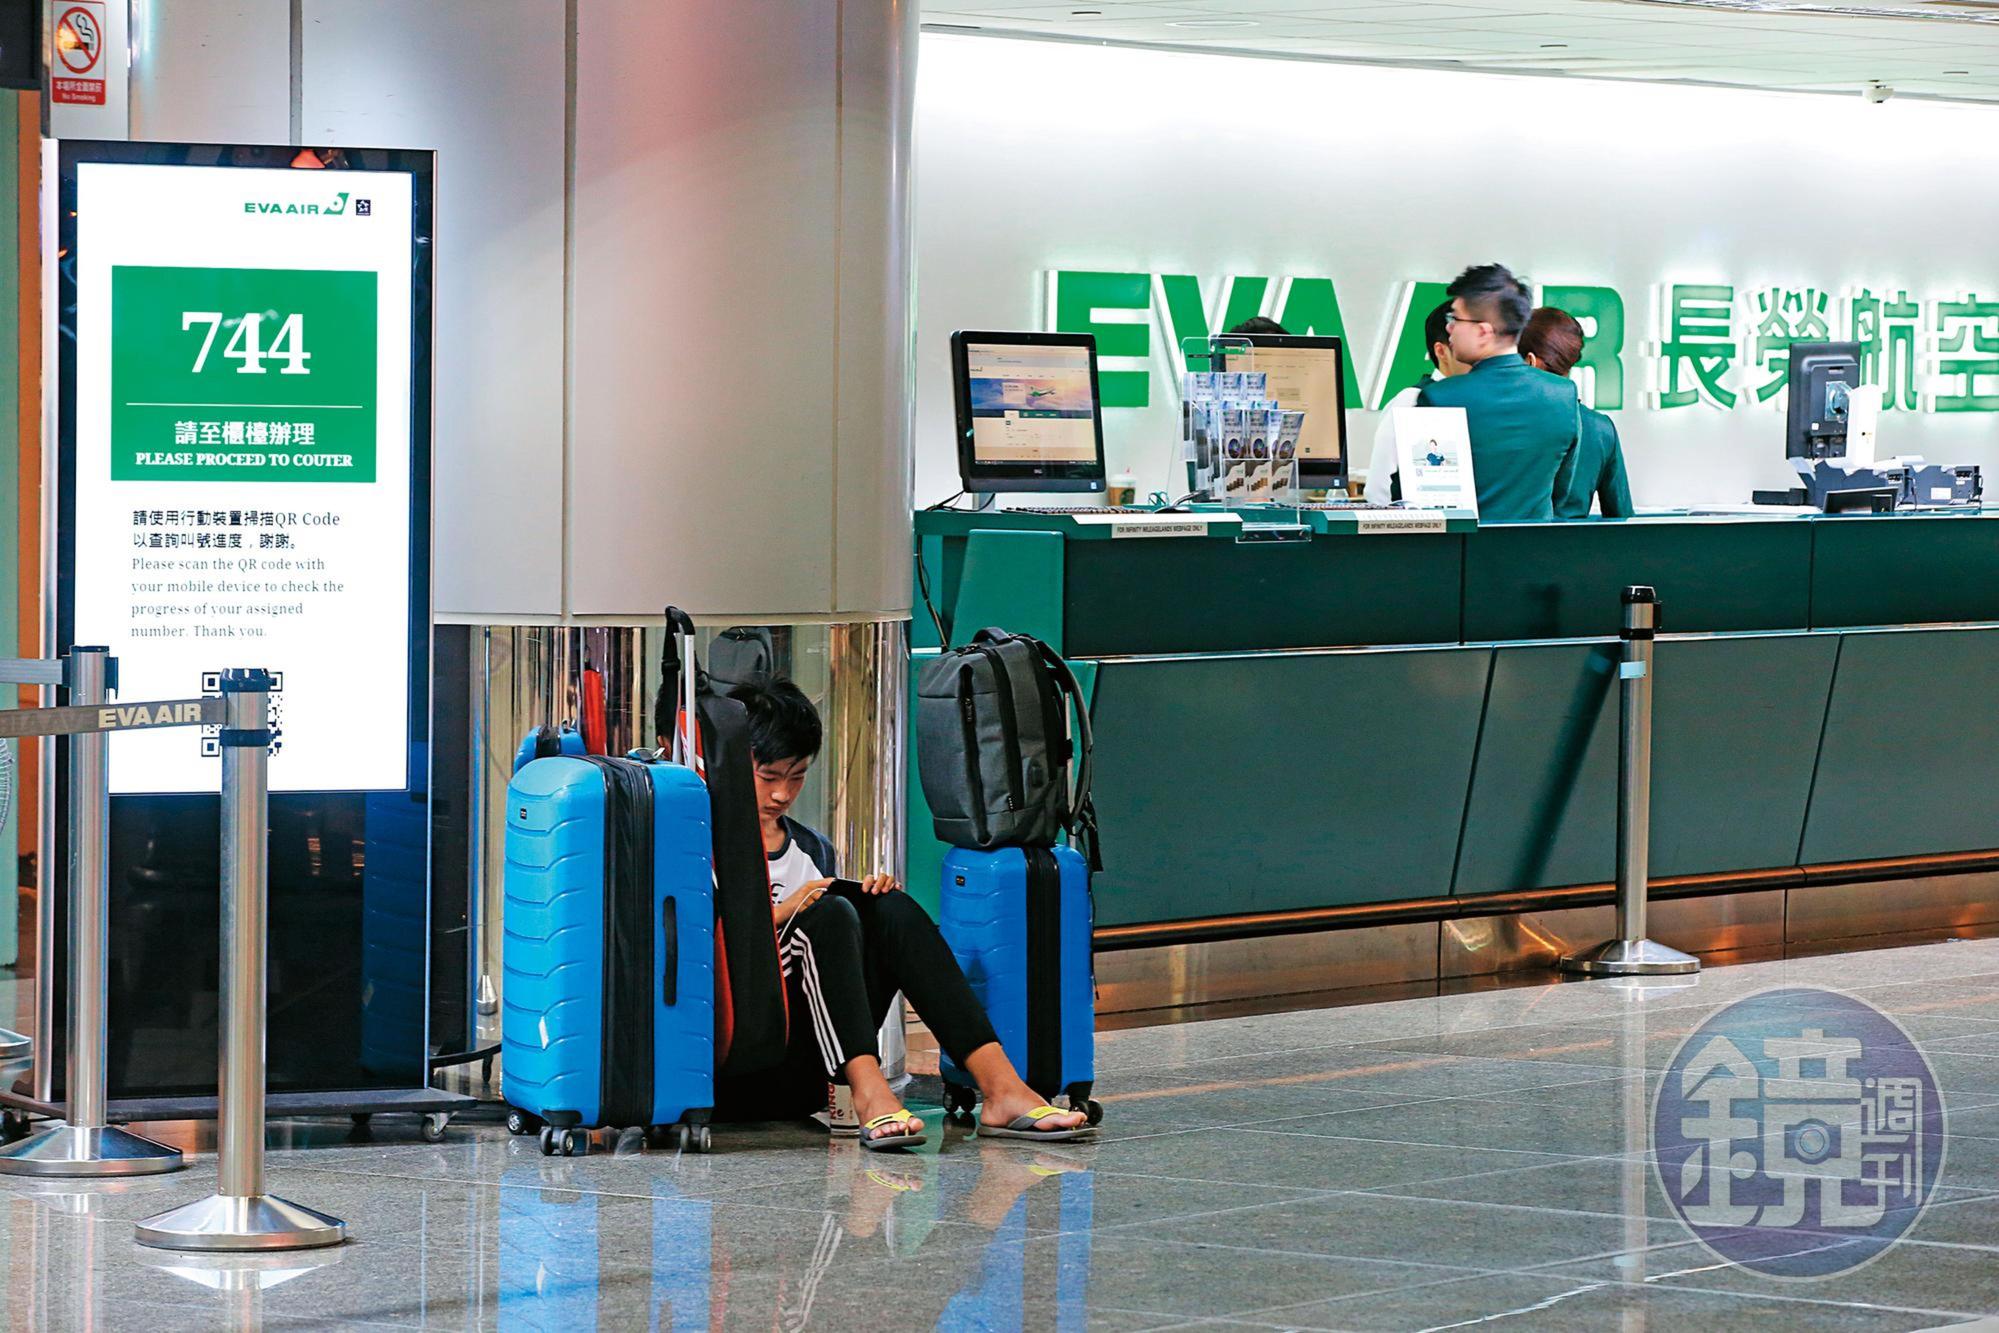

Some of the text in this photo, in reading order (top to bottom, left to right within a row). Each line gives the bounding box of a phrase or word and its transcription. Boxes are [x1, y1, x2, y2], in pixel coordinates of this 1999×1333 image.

[71, 92, 97, 103] Smoking
[182, 311, 311, 375] 744
[1655, 283, 1999, 413] 長榮航空
[175, 420, 316, 446] 請至櫃檯辦理
[135, 452, 354, 467] PLEASE PROCEED TO COUTER
[302, 511, 341, 526] Code
[132, 557, 325, 574] Please scan the QR code with
[131, 579, 344, 596] your mobile device to check the
[131, 602, 304, 619] progress of your assigned
[131, 625, 267, 640] number. Thank you.
[828, 1083, 837, 1120] KING
